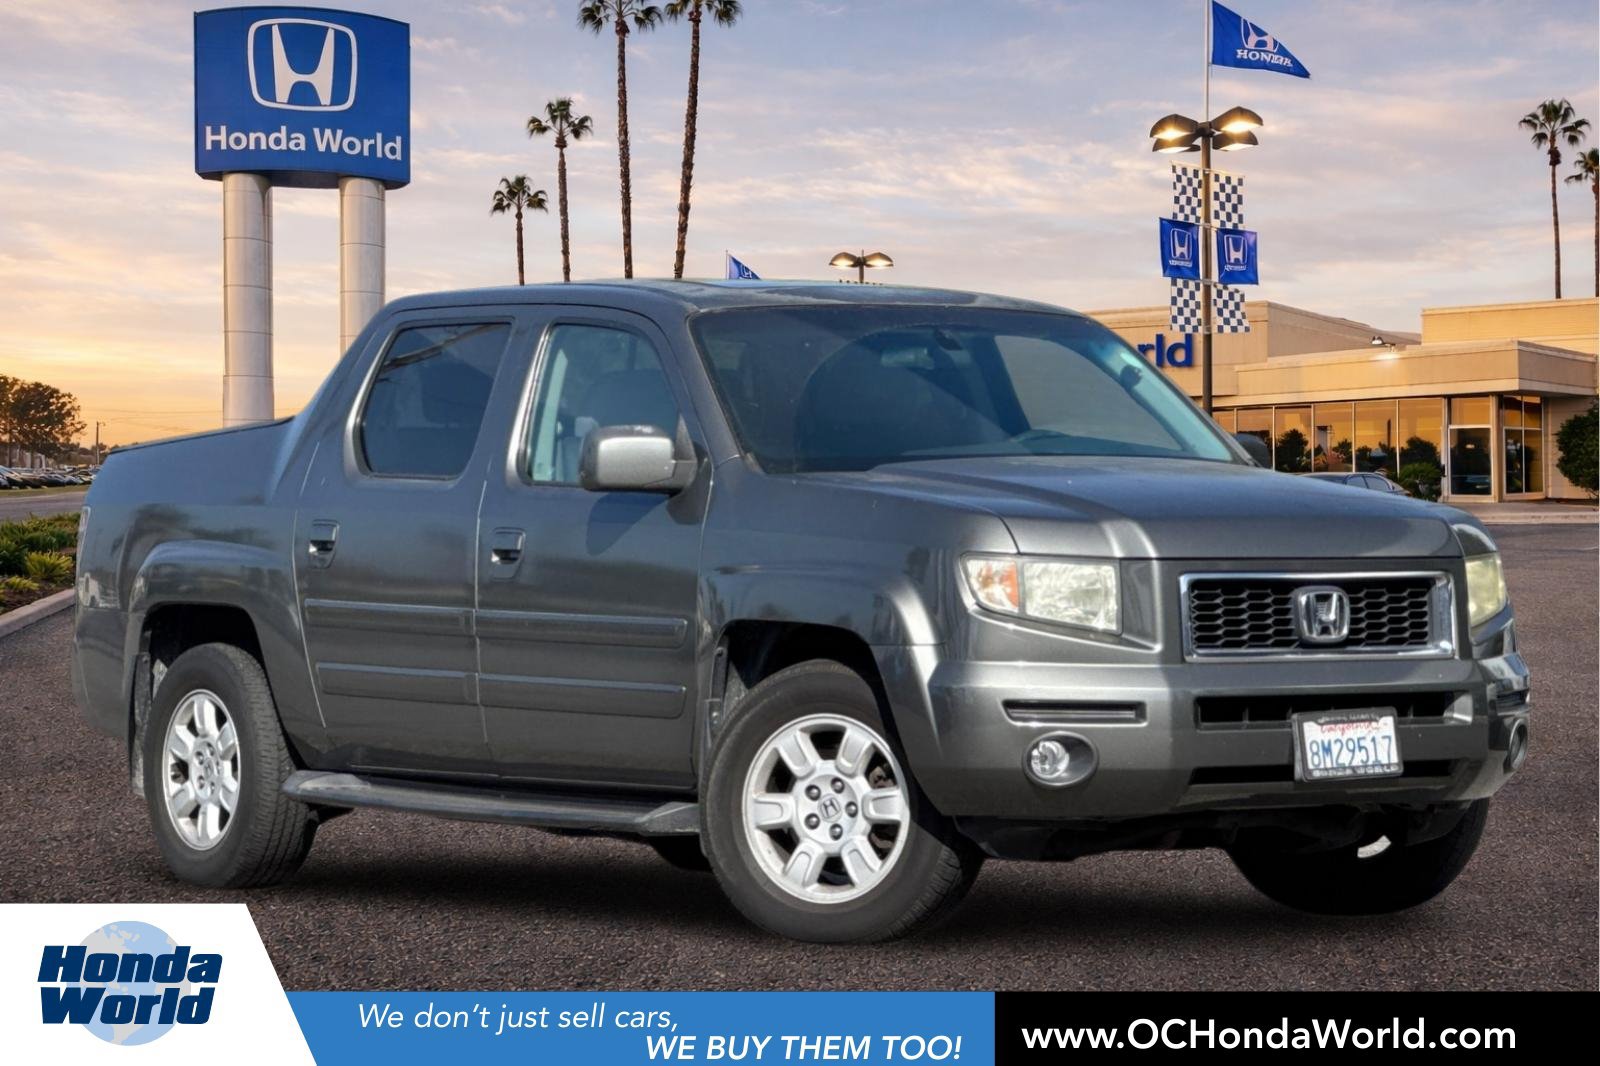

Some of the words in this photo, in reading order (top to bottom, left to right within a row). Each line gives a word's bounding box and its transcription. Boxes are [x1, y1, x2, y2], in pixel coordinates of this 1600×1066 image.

[205, 125, 306, 151] Honda
[313, 127, 402, 161] World
[1137, 333, 1194, 368] rld
[1309, 735, 1392, 768] 8M29517
